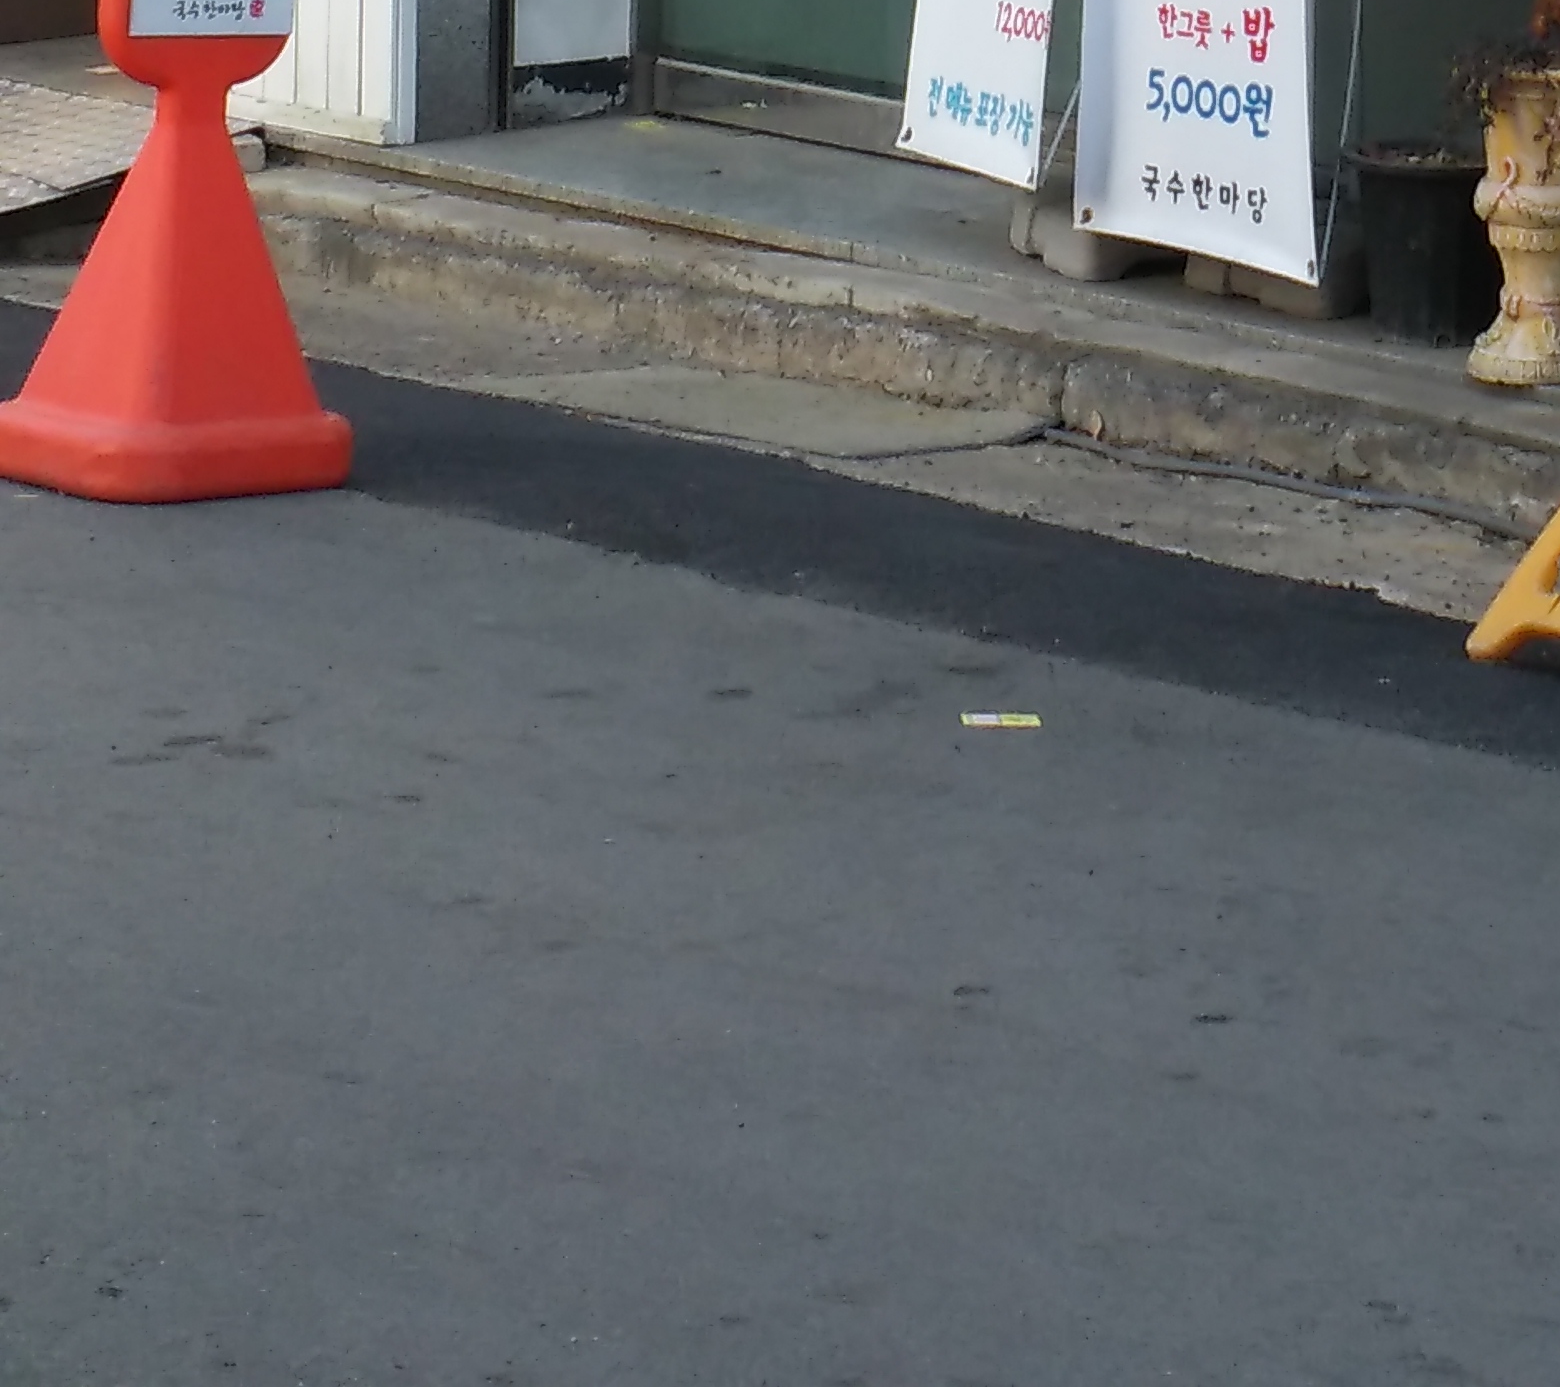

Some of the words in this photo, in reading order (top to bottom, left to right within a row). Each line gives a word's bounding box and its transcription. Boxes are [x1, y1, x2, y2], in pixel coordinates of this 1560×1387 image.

[1157, 2, 1213, 51] 한그릇
[1242, 6, 1276, 63] 밥
[1146, 67, 1274, 139] 5,000원
